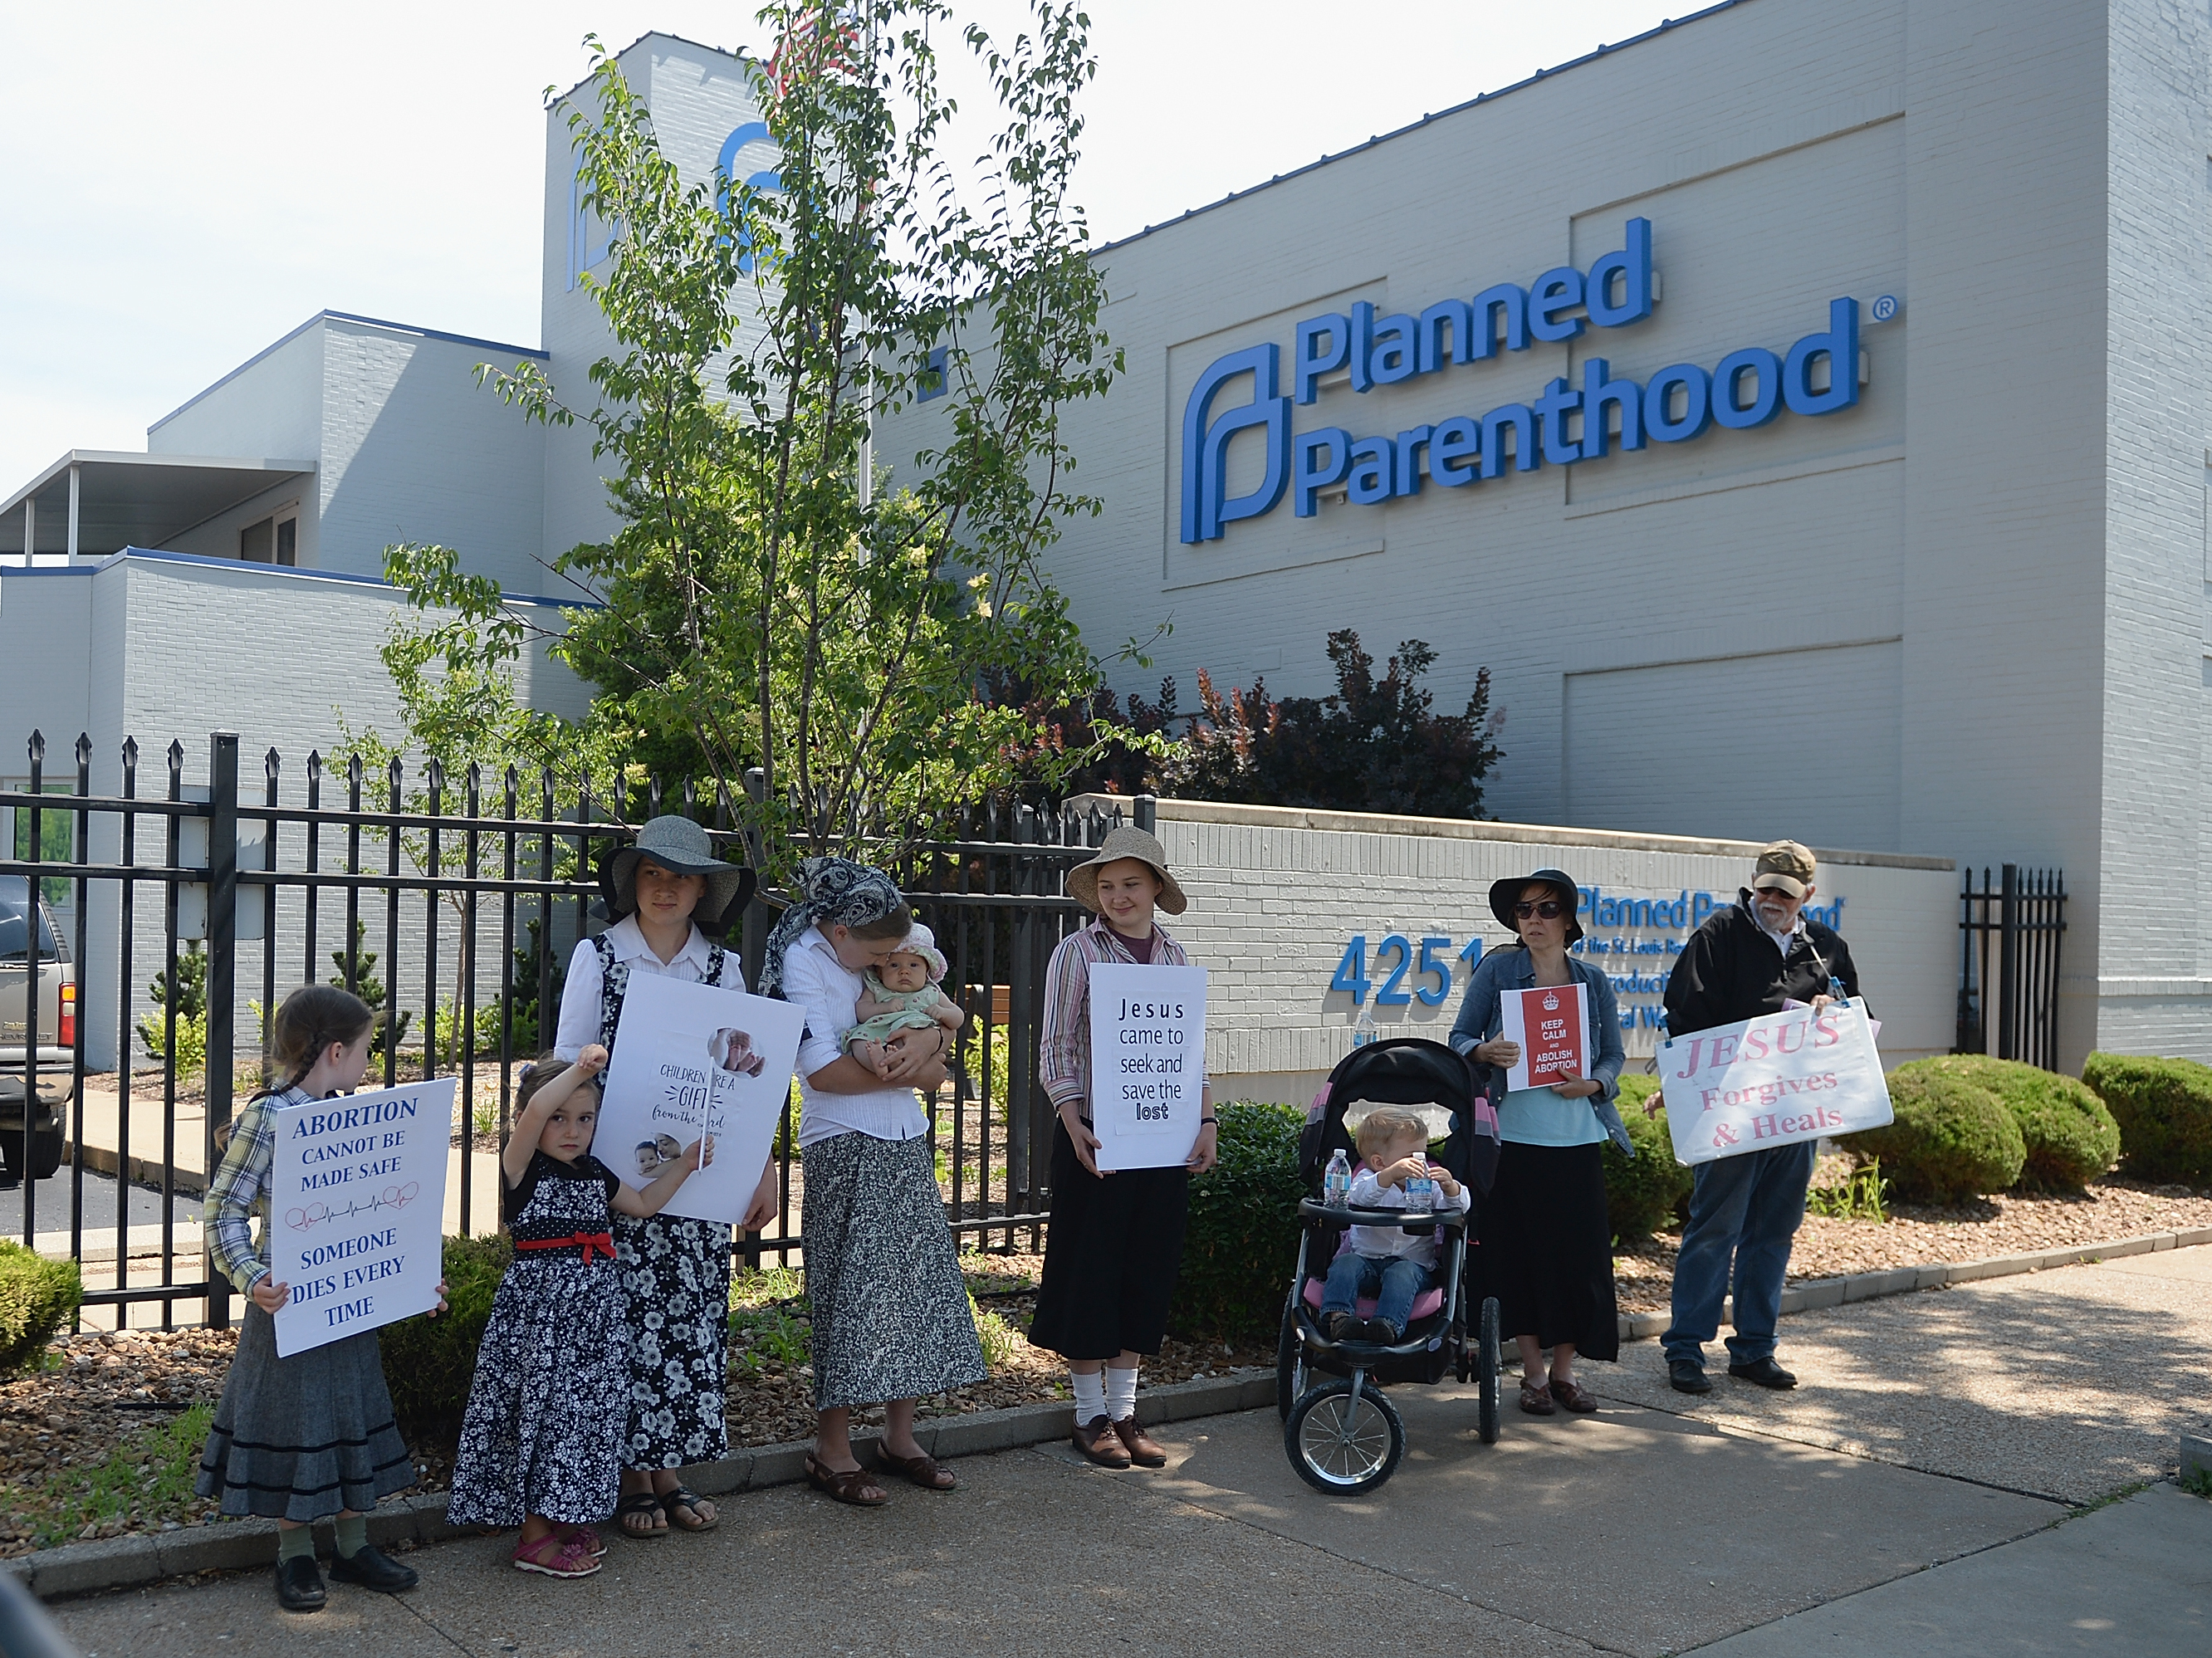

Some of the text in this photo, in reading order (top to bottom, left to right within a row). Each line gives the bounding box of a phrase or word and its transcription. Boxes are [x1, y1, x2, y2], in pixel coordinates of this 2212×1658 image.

[1296, 217, 1652, 404] Planned
[1294, 296, 1861, 518] Parenthood
[1573, 935, 1587, 953] of
[1588, 936, 1609, 953] the
[1613, 937, 1629, 954] St.
[1632, 937, 1664, 955] Louis
[1331, 935, 1483, 1006] 4251
[1118, 998, 1184, 1021] Jesus
[1119, 1028, 1184, 1044] came to
[1541, 1019, 1564, 1030] KEEP
[1542, 1030, 1567, 1040] CALM
[1536, 1049, 1573, 1063] ABOLISH
[1676, 1015, 1840, 1079] JESUS
[1120, 1053, 1182, 1074] seek and
[1534, 1059, 1578, 1074] ABORTION
[660, 1064, 707, 1083] CHILDREN
[727, 1078, 735, 1090] A
[1122, 1079, 1182, 1100] save the
[678, 1086, 707, 1109] GIFT
[1700, 1072, 1838, 1112] Forgives
[292, 1097, 418, 1139] ABORTION
[653, 1104, 679, 1120] from
[679, 1111, 697, 1124] the
[1136, 1102, 1169, 1121] lost
[1712, 1107, 1843, 1147] & Heals
[301, 1130, 405, 1165] CANNOT BE
[301, 1157, 402, 1192] MADE SAFE
[301, 1228, 397, 1270] SOMEONE
[291, 1255, 406, 1305] DIES EVERY
[324, 1296, 374, 1327] TIME
